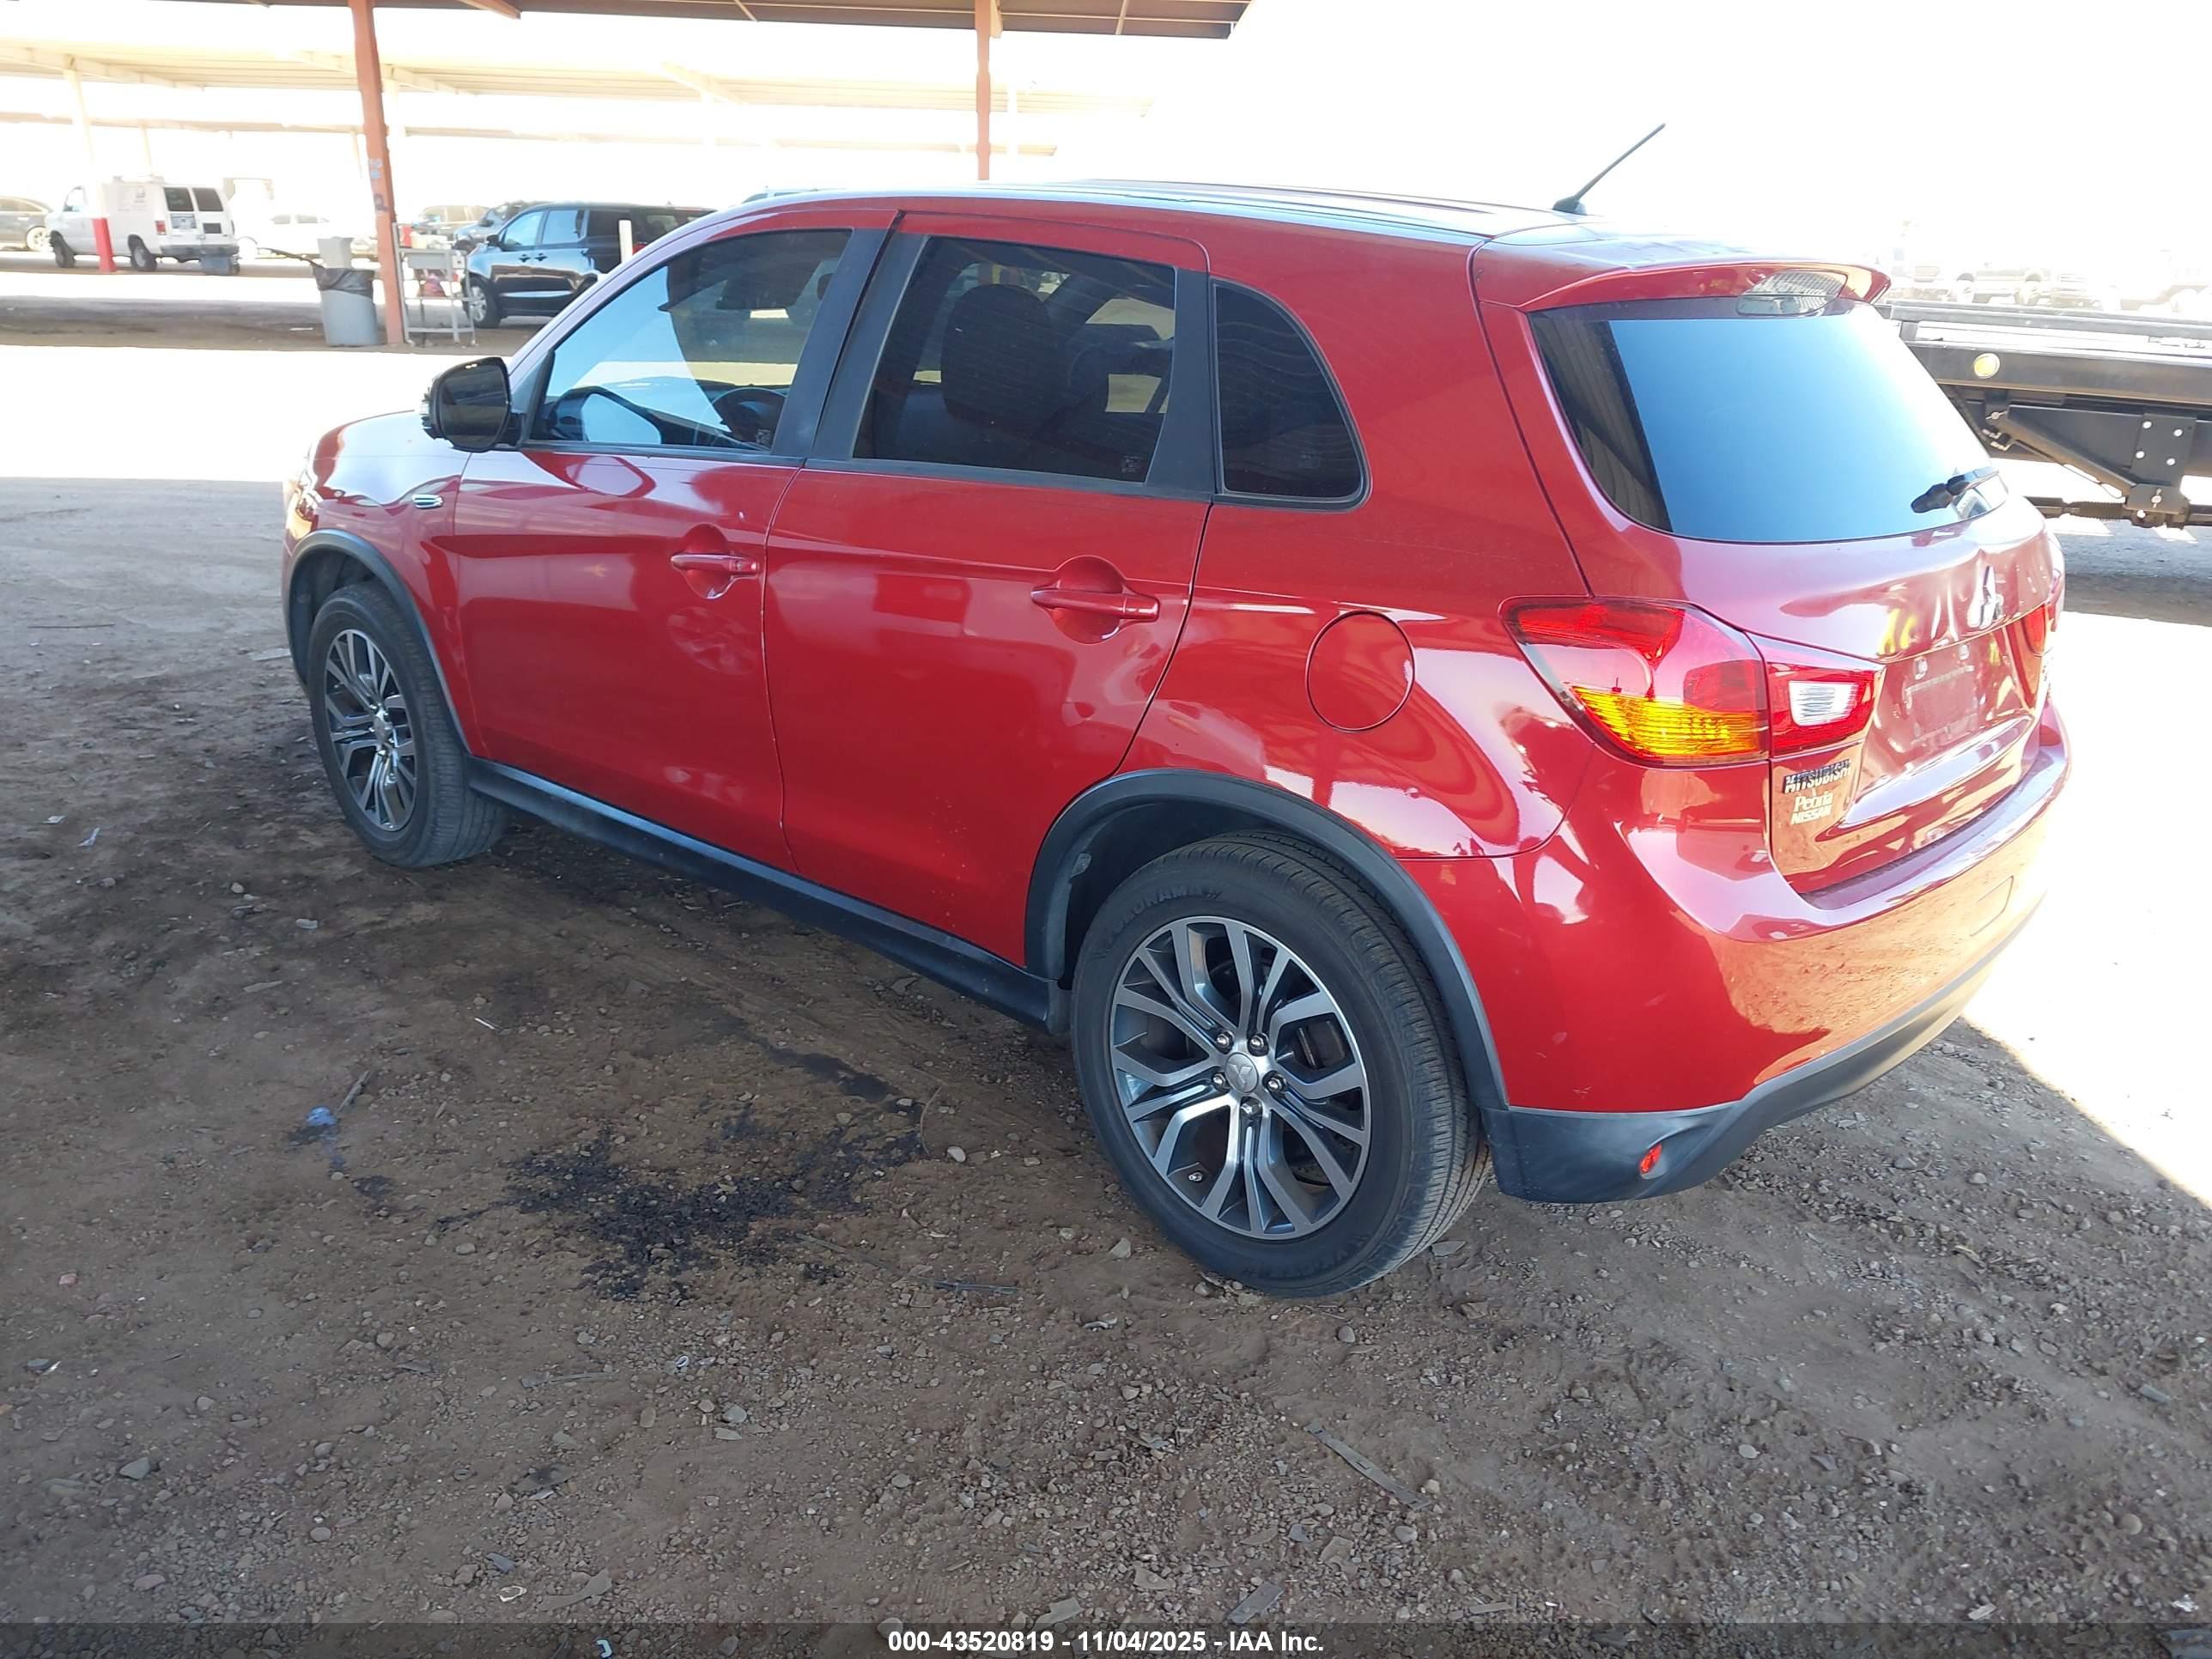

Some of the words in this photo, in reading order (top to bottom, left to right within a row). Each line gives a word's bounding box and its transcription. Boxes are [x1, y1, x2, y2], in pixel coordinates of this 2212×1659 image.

[1784, 759, 1851, 794] MITSUBISHI
[1793, 791, 1834, 812] Peoria
[1791, 805, 1833, 825] NISSAN
